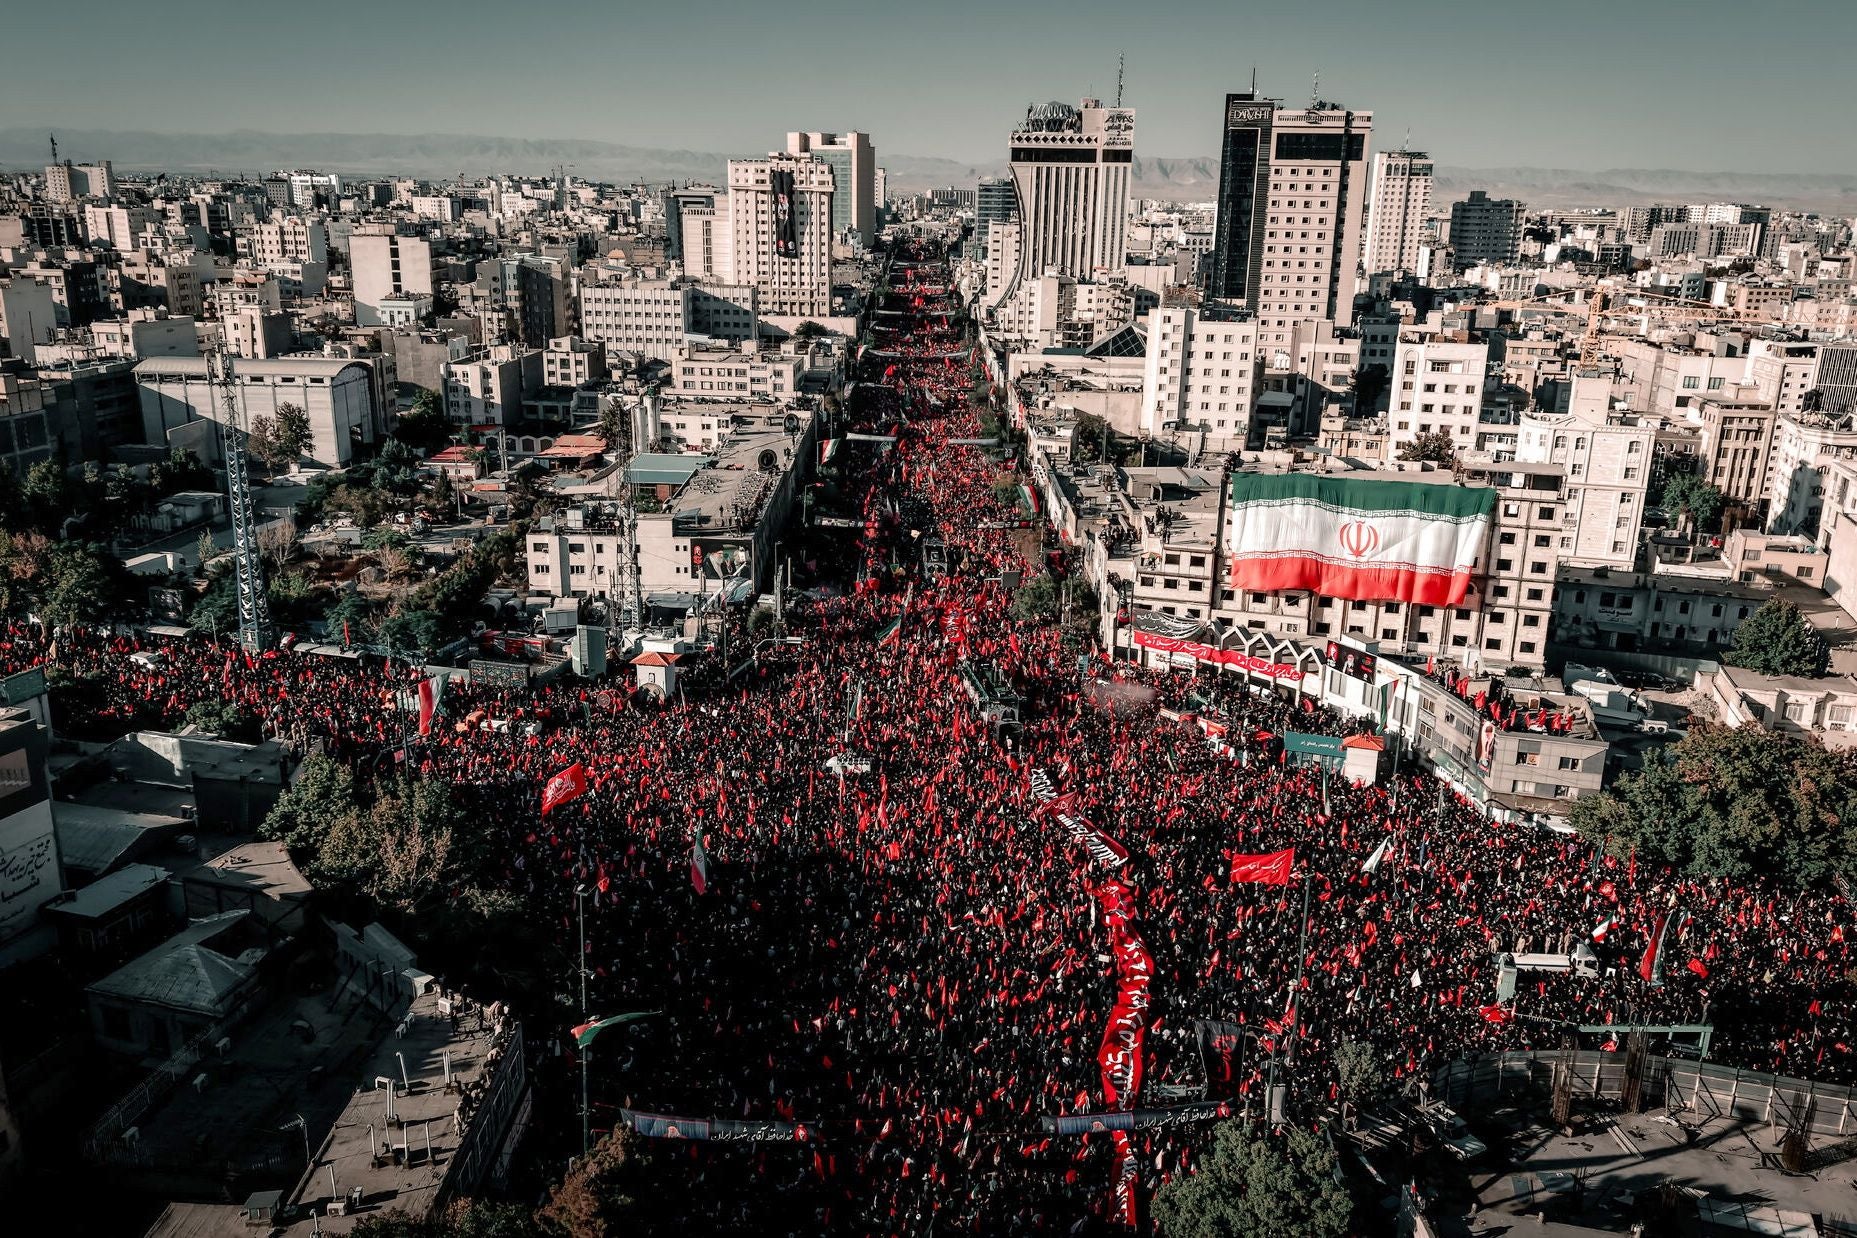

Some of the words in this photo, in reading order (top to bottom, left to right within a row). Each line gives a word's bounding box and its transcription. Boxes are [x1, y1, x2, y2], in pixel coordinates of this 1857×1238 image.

[1135, 1117, 1156, 1130] ایران
[1157, 1111, 1173, 1126] شهید
[710, 1130, 731, 1141] ایران
[732, 1127, 749, 1140] شهید
